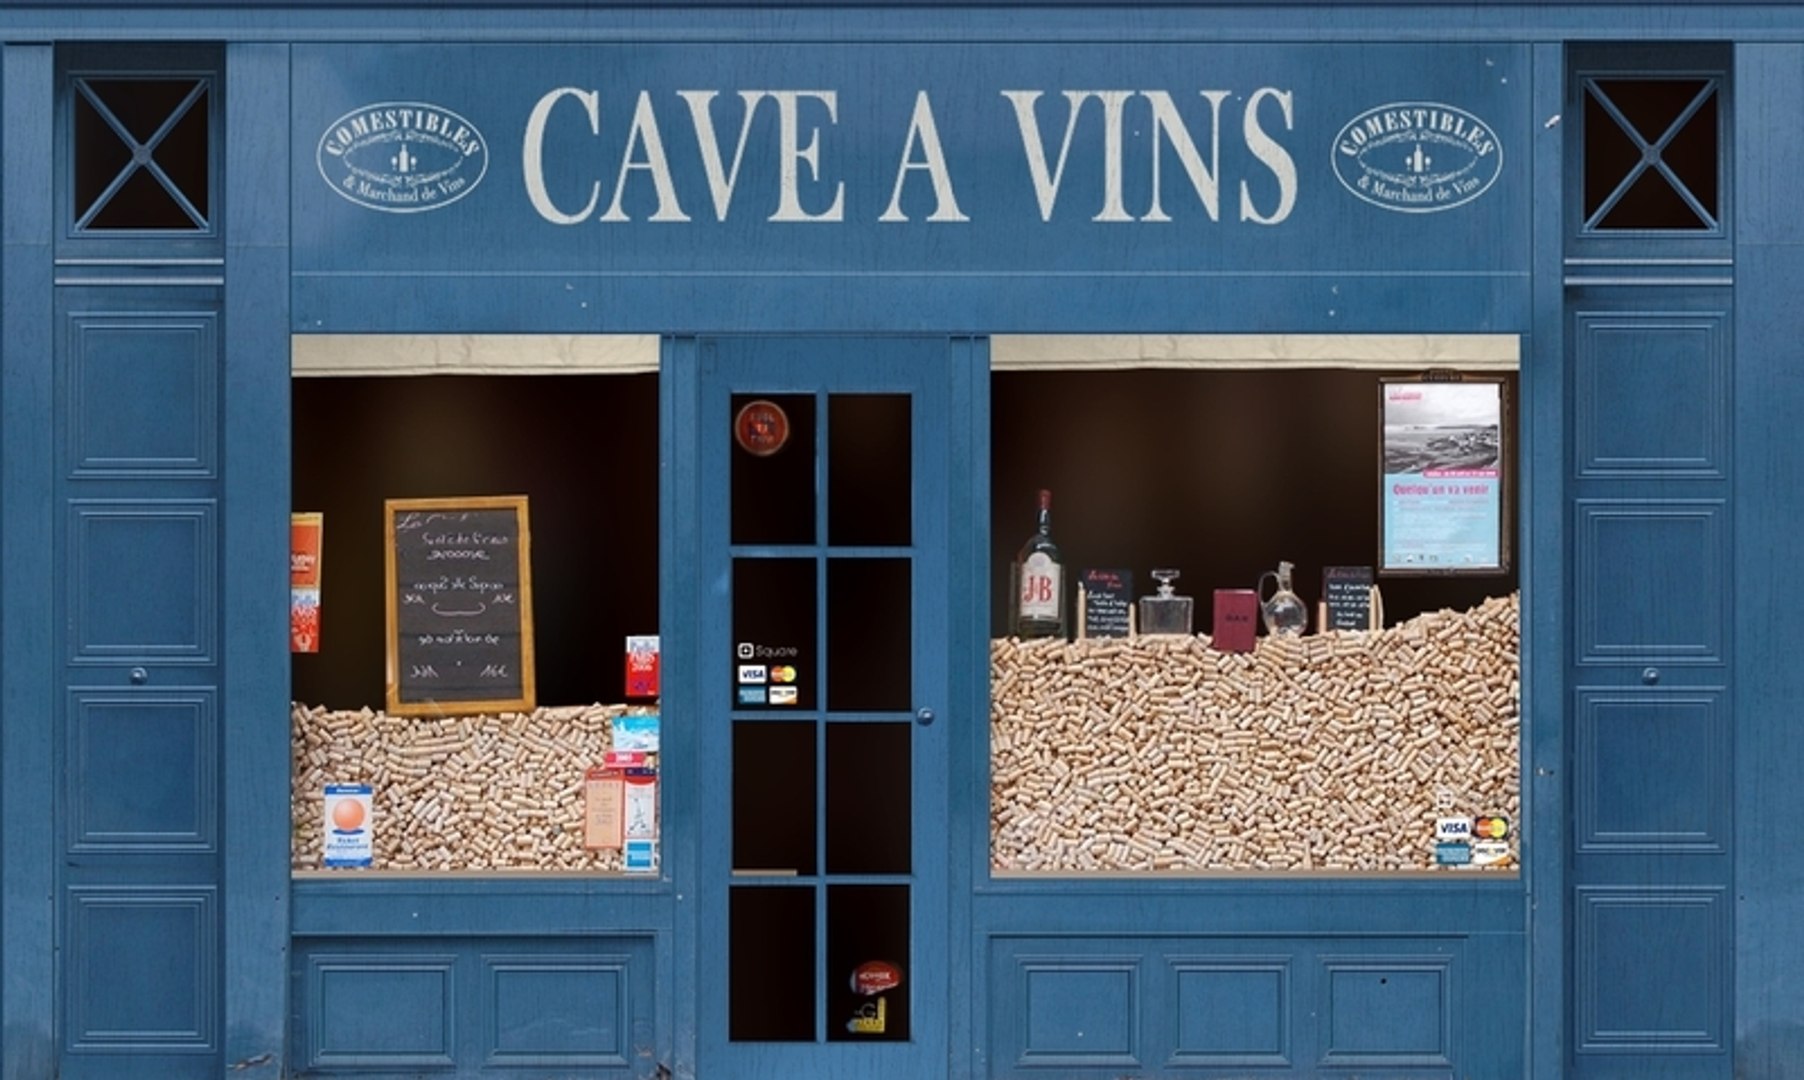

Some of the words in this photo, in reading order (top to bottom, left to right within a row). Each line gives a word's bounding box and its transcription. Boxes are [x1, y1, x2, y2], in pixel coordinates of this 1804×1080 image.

[326, 109, 480, 157] COMESTIBLES
[1340, 109, 1494, 157] COMESTIBLES
[522, 87, 845, 224] CAVE
[878, 90, 970, 221] A
[1001, 87, 1298, 224] VINS
[343, 175, 356, 189] &
[356, 181, 419, 202] Marchand
[421, 187, 437, 200] de
[437, 177, 466, 196] Vins
[1357, 175, 1370, 189] &
[1370, 181, 1433, 202] Marchand
[1435, 187, 1451, 200] de
[1451, 177, 1480, 196] Vins
[755, 644, 798, 658] Square
[742, 669, 764, 679] VISA
[1441, 823, 1468, 833] VISA
